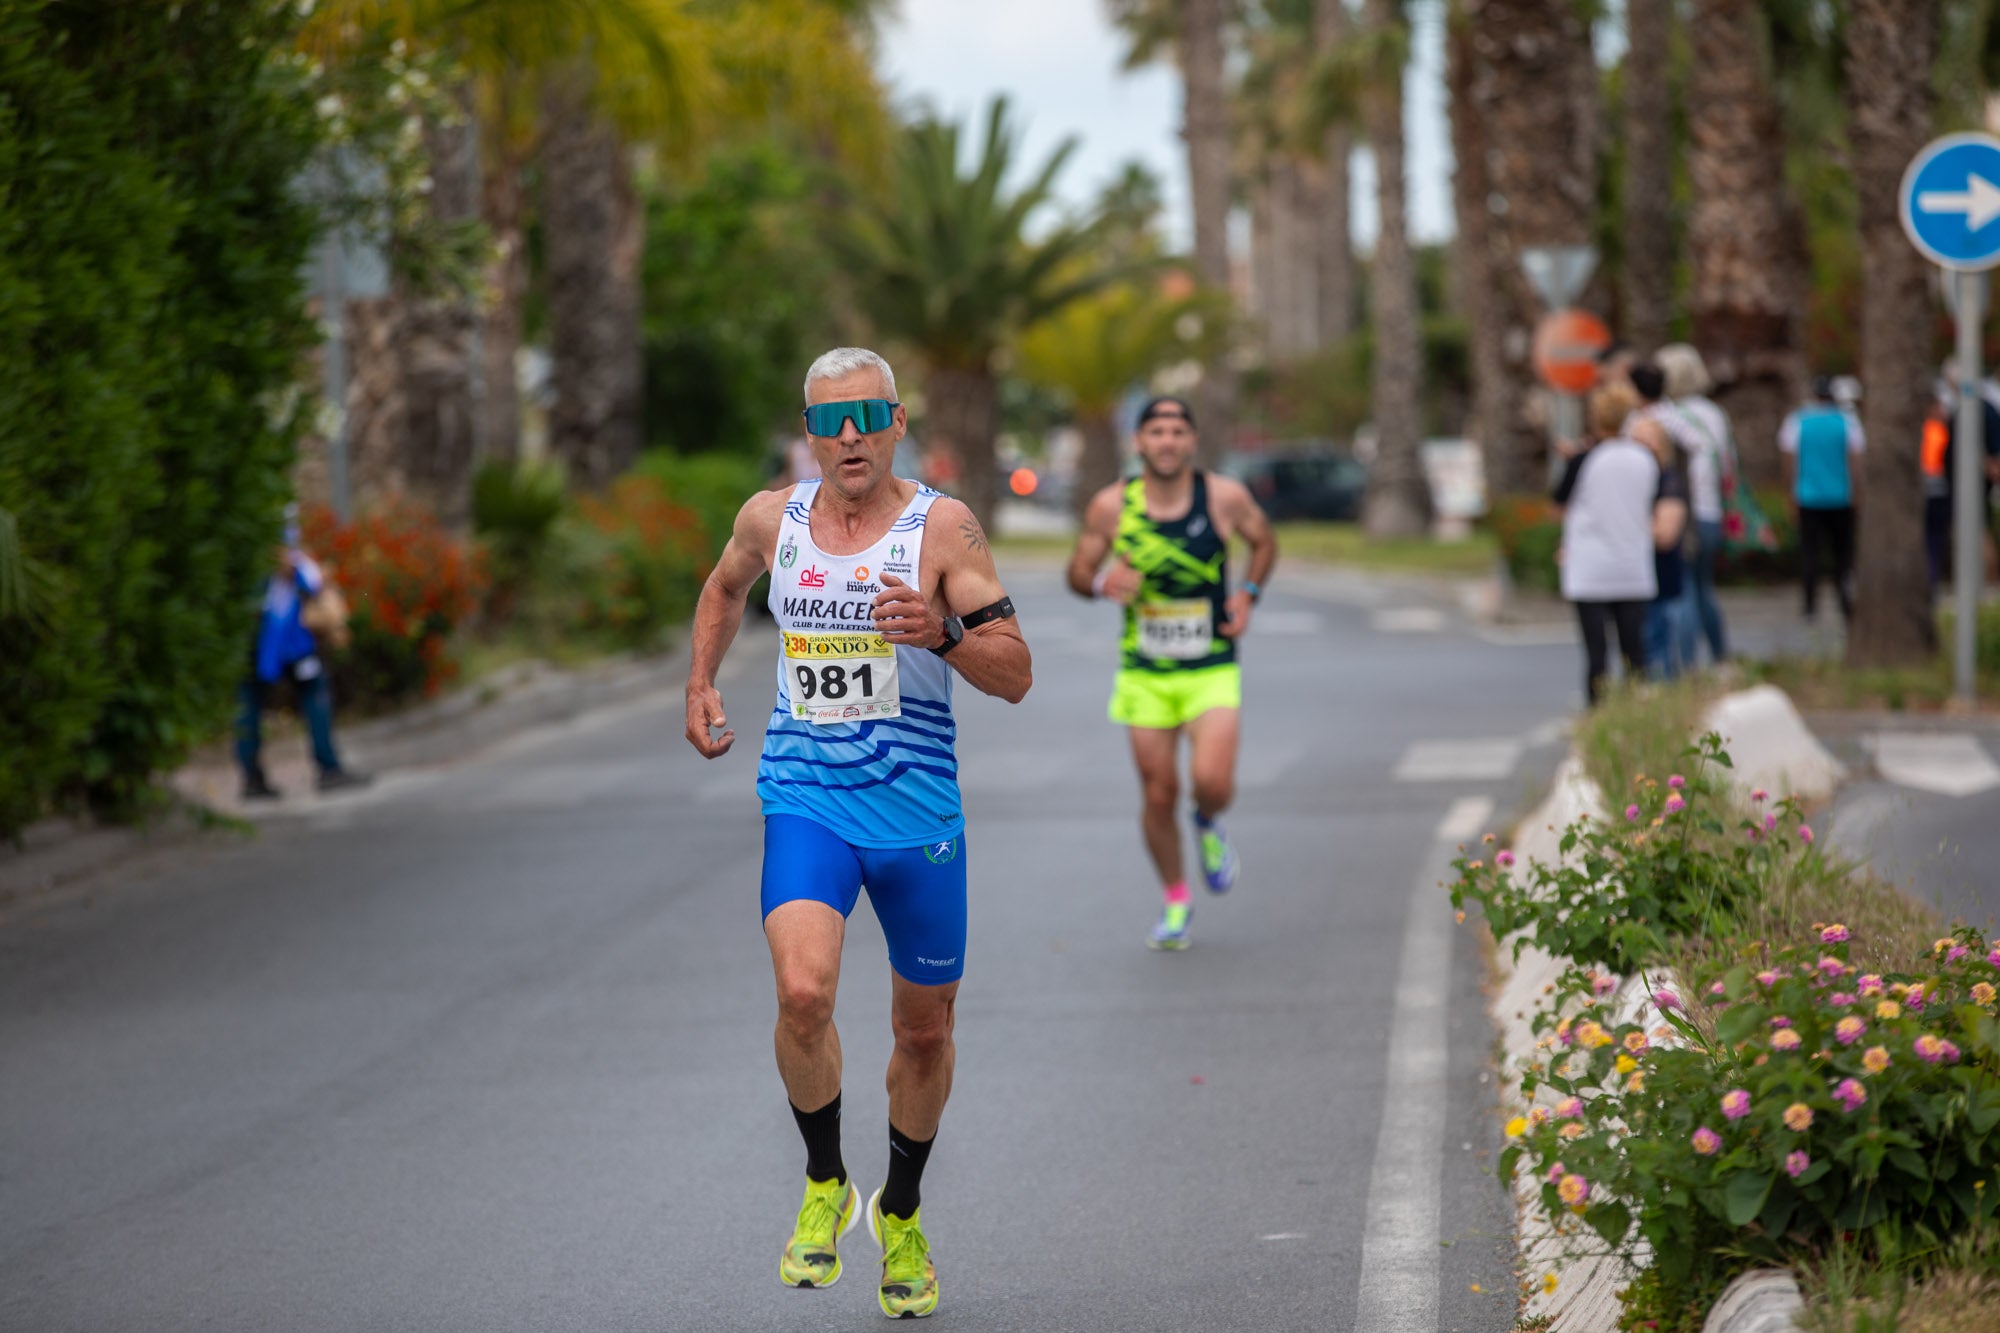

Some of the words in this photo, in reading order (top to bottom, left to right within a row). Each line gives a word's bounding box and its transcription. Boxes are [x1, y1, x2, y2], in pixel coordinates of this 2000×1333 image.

[783, 597, 896, 621] MARACE
[828, 623, 876, 632] ATLETISM
[791, 636, 808, 653] 38
[807, 641, 869, 654] FONDO
[796, 664, 873, 699] 981
